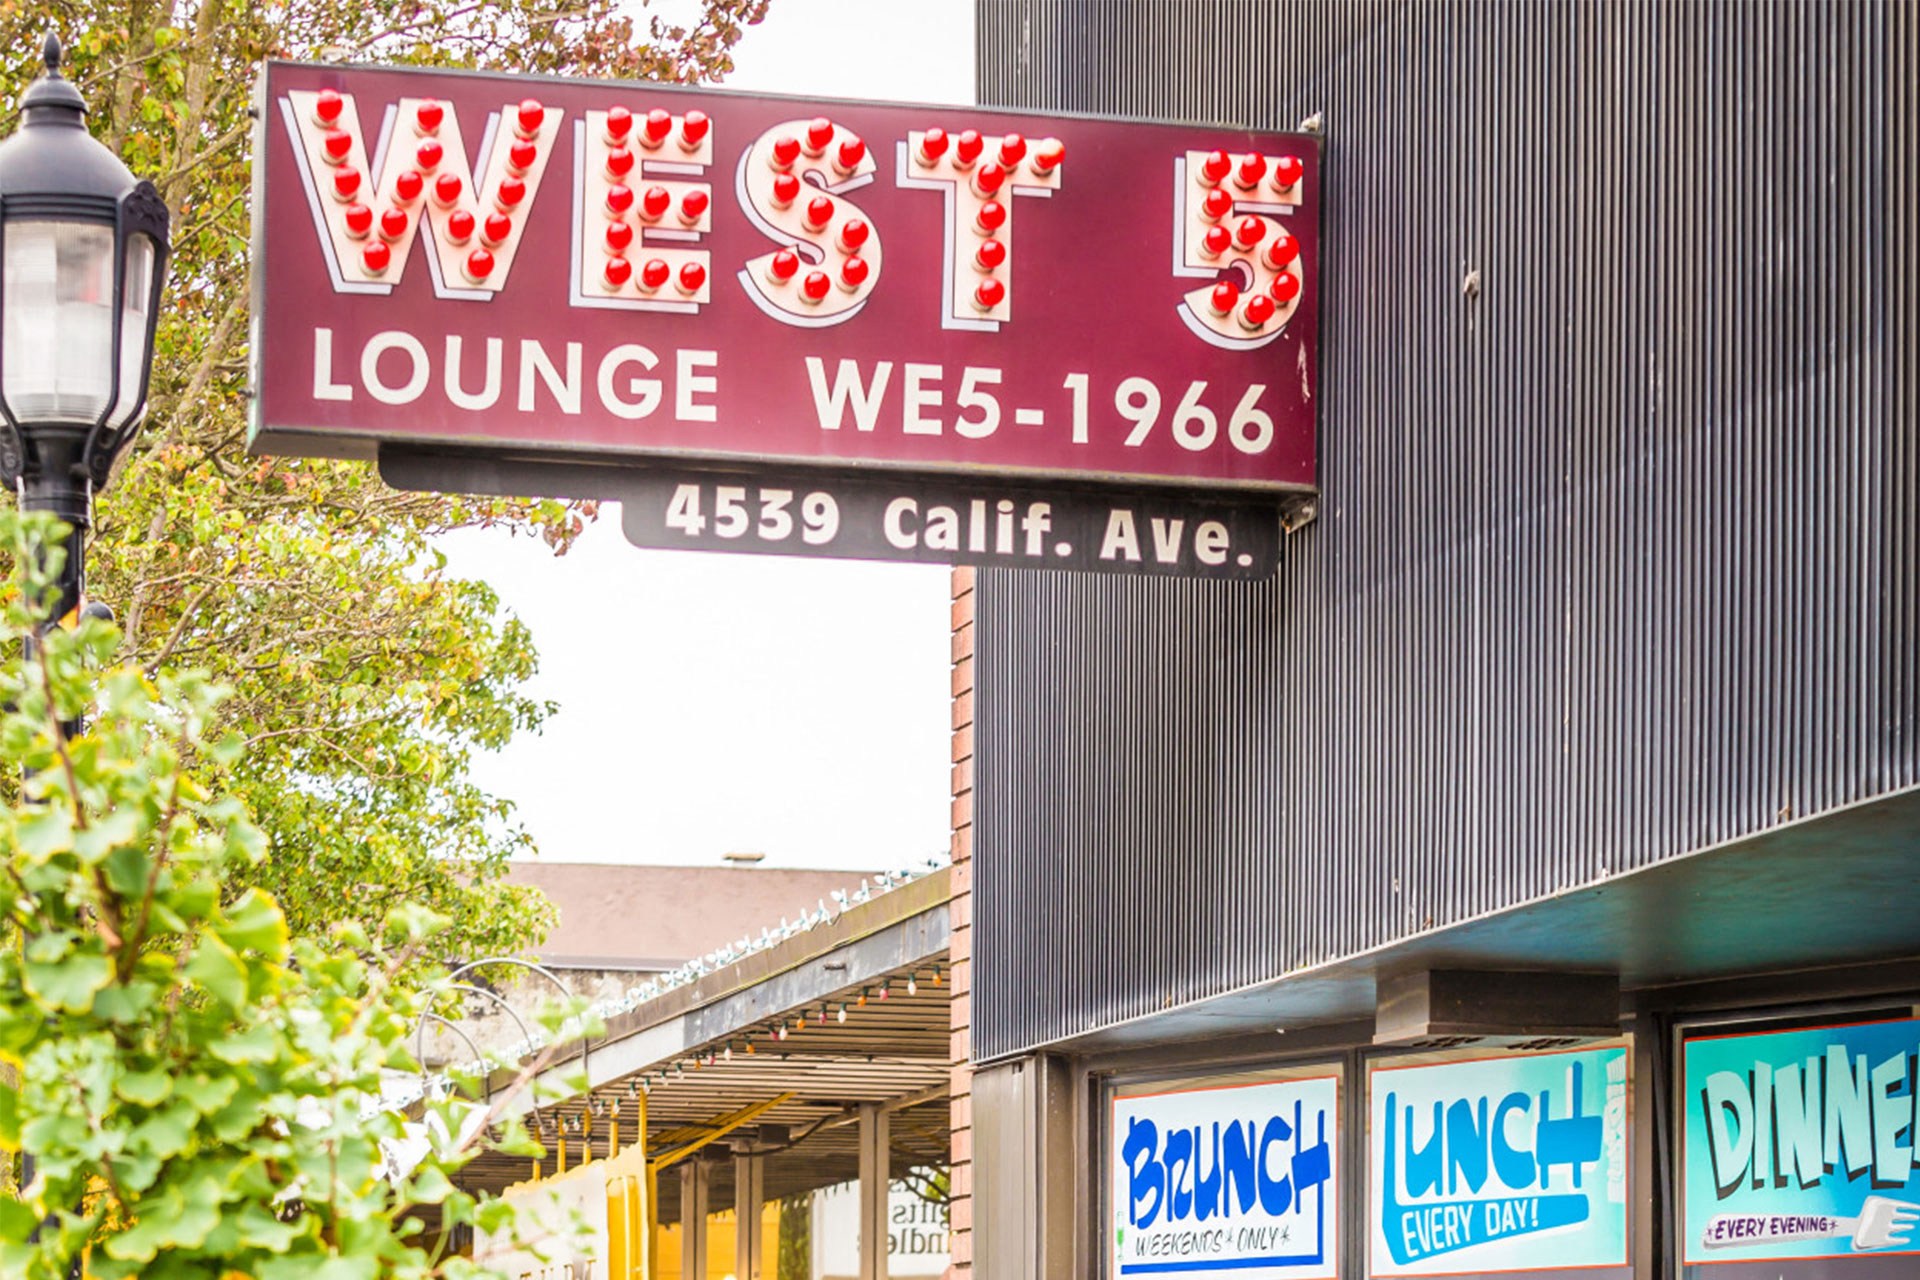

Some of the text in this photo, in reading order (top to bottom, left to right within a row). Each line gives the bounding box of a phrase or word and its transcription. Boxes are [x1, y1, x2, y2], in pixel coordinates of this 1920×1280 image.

[277, 90, 1304, 351] WEST 5
[313, 327, 1274, 455] LOUNGE WE5-1966
[665, 484, 1254, 568] 4539 Calif. Ave.
[1122, 1099, 1331, 1230] BRUNCH
[1382, 1061, 1603, 1200] LUNCH
[1701, 1042, 1920, 1201] DINNE
[1136, 1226, 1280, 1257] WEEKENDS ONLY
[1401, 1197, 1539, 1258] EVERY DAY!
[1714, 1216, 1829, 1240] EVERY EVENING
